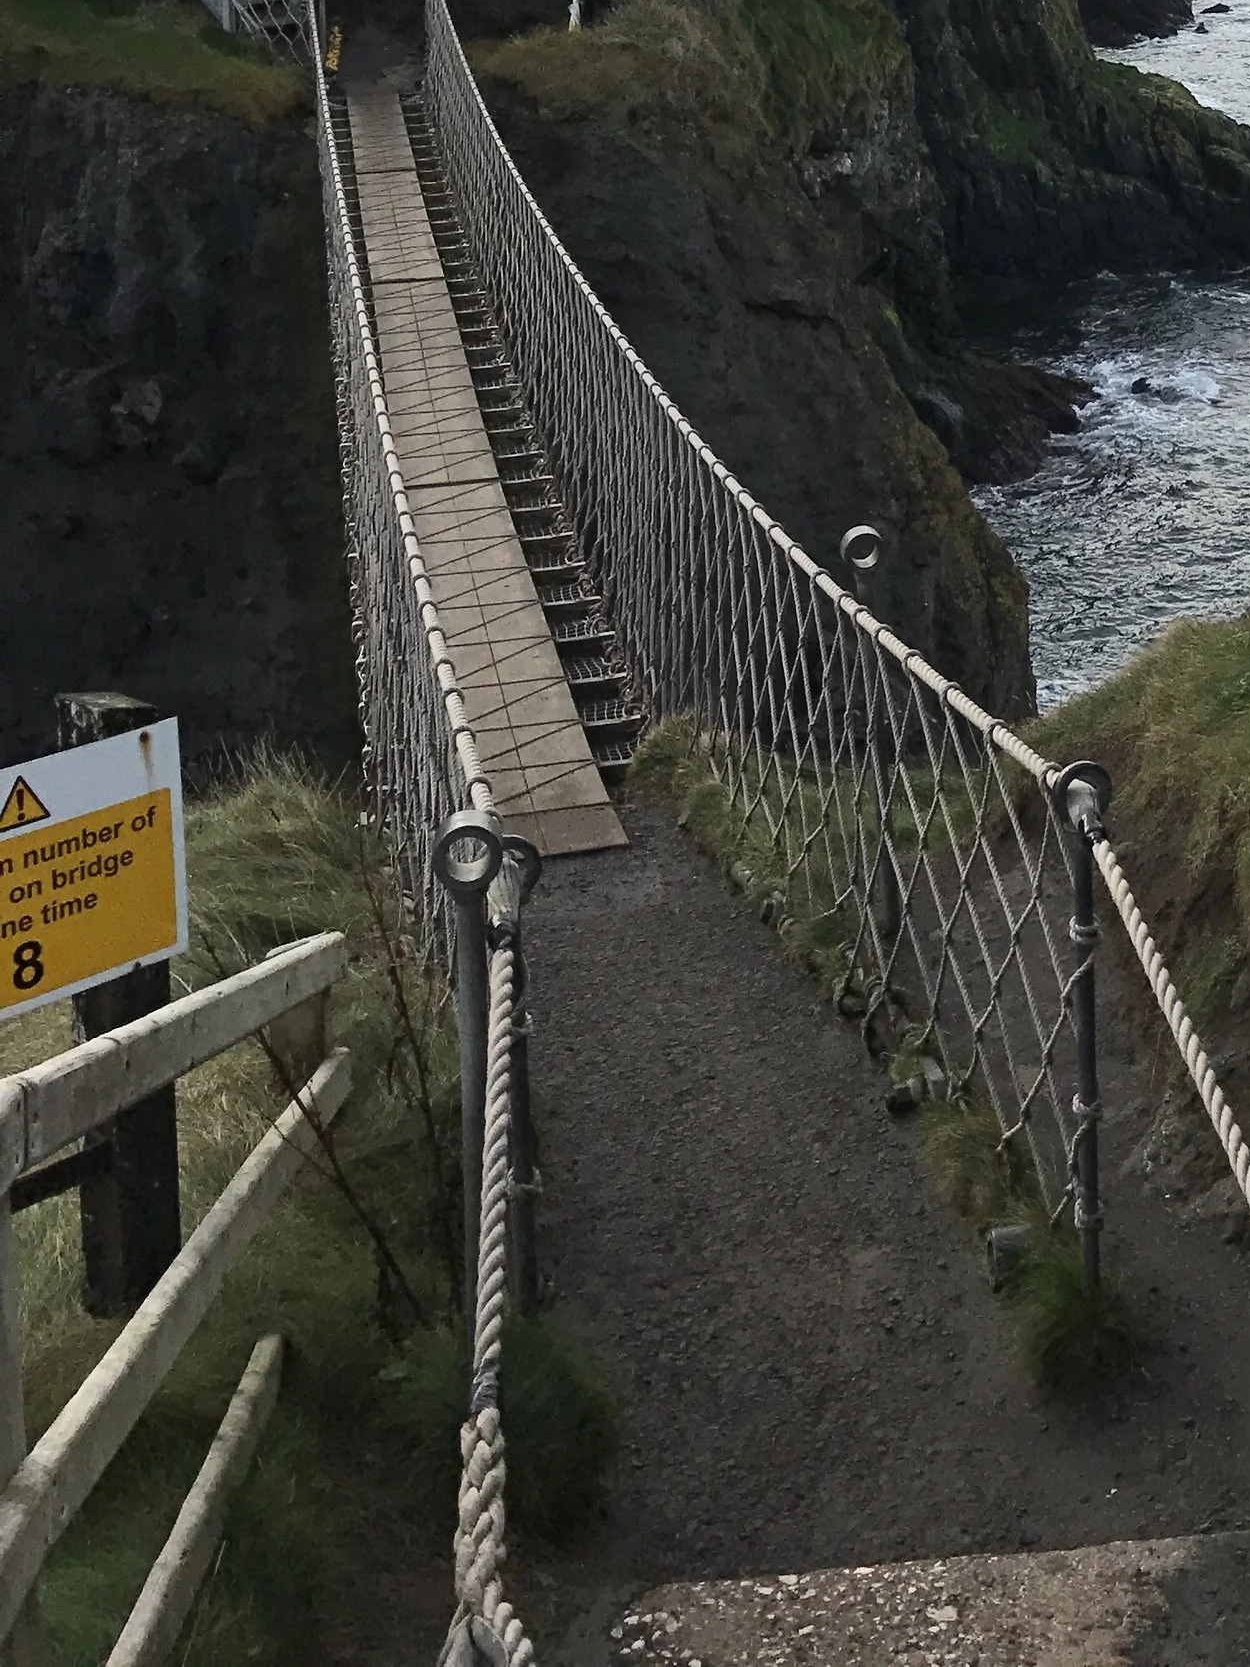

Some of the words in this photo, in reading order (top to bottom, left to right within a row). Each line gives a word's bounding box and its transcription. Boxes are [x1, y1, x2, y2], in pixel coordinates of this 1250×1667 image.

[23, 822, 124, 868] number
[131, 806, 157, 832] of
[9, 880, 42, 903] on
[52, 850, 134, 889] bridge
[0, 915, 33, 939] ne
[41, 893, 99, 924] time
[13, 940, 44, 990] 8
